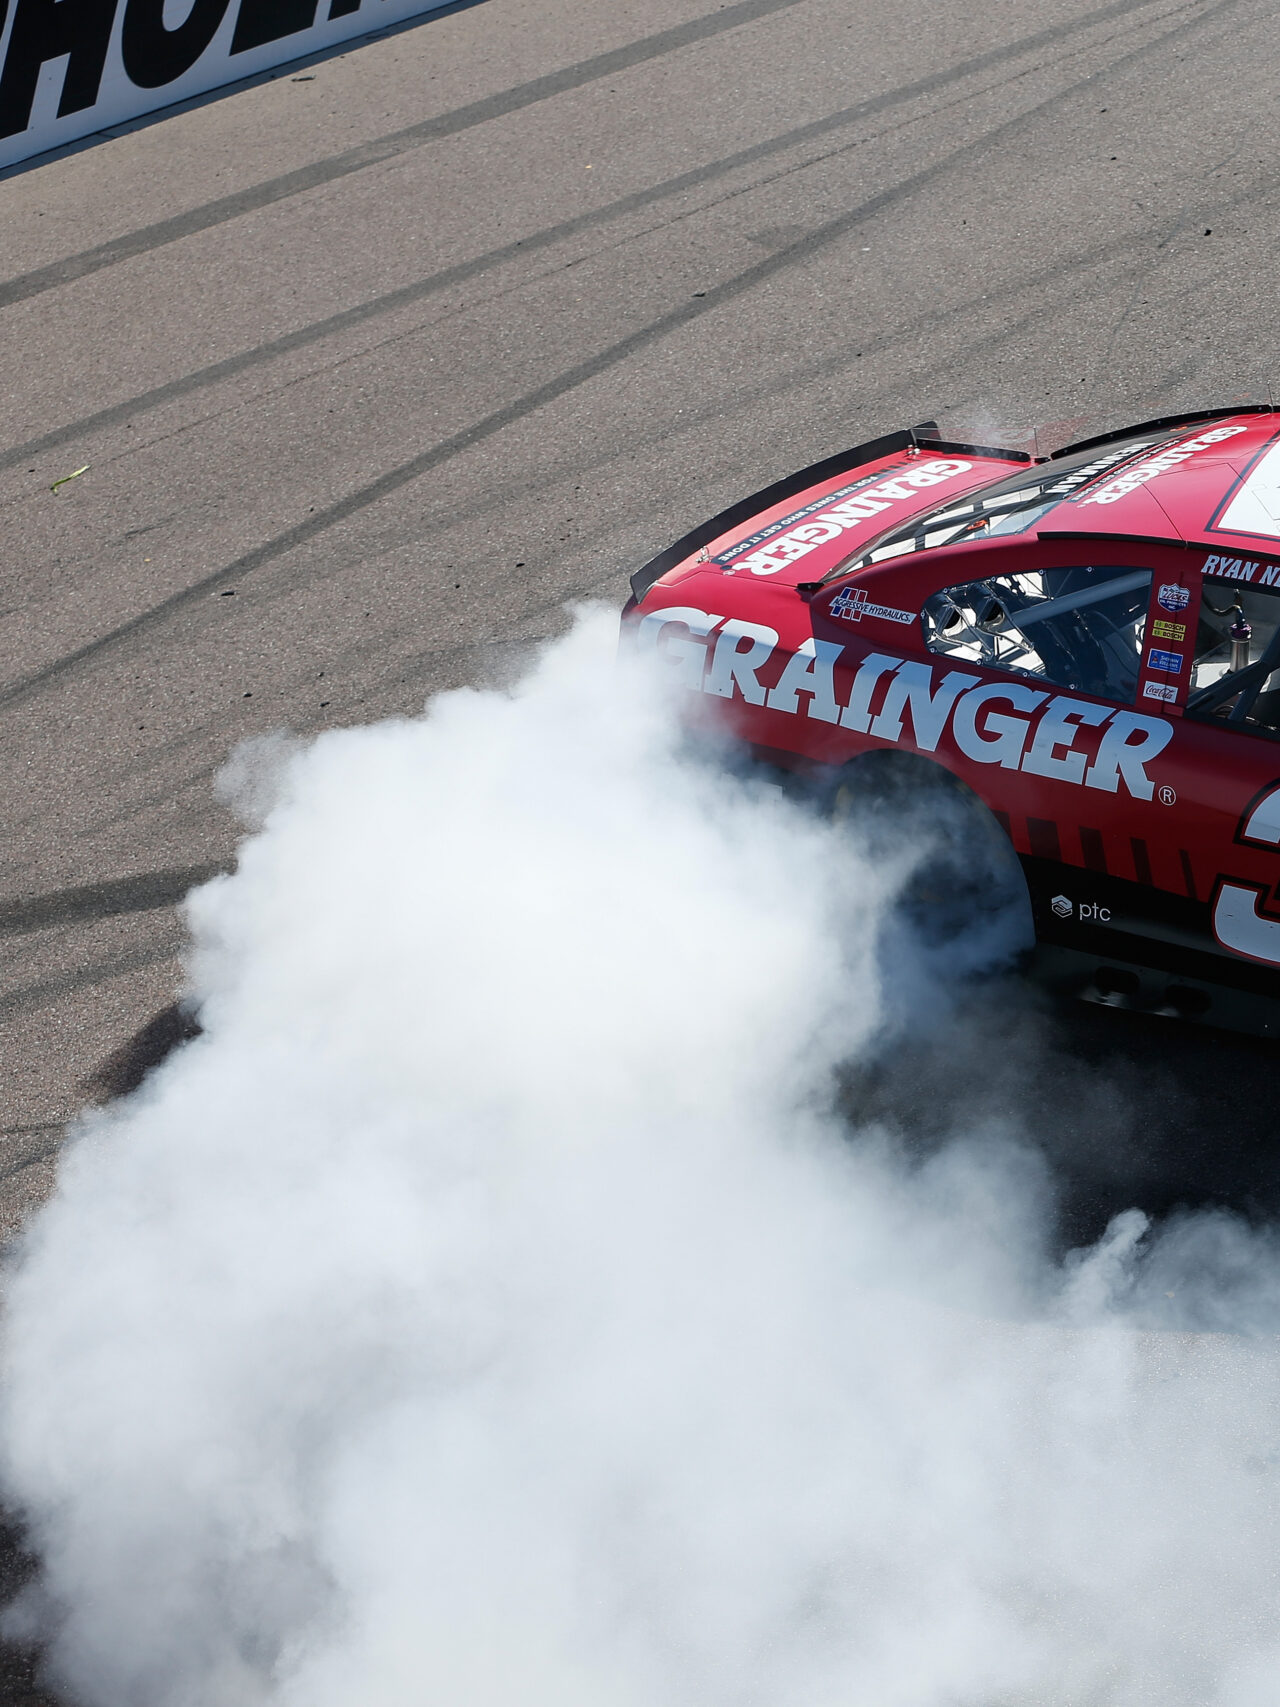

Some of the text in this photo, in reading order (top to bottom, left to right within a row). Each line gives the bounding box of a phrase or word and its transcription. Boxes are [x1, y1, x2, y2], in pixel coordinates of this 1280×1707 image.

[1084, 426, 1248, 504] GRAINGER
[720, 475, 881, 562] FOR THE ONES WHO GET IT DONE
[731, 460, 973, 576] GRAINGER
[1200, 554, 1260, 581] RYAN
[833, 599, 870, 612] AGGRESSIVE
[1162, 631, 1183, 639] BOSCH
[1164, 623, 1184, 631] BOSCH
[638, 606, 1173, 801] GRAINGER
[1079, 902, 1111, 921] ptc
